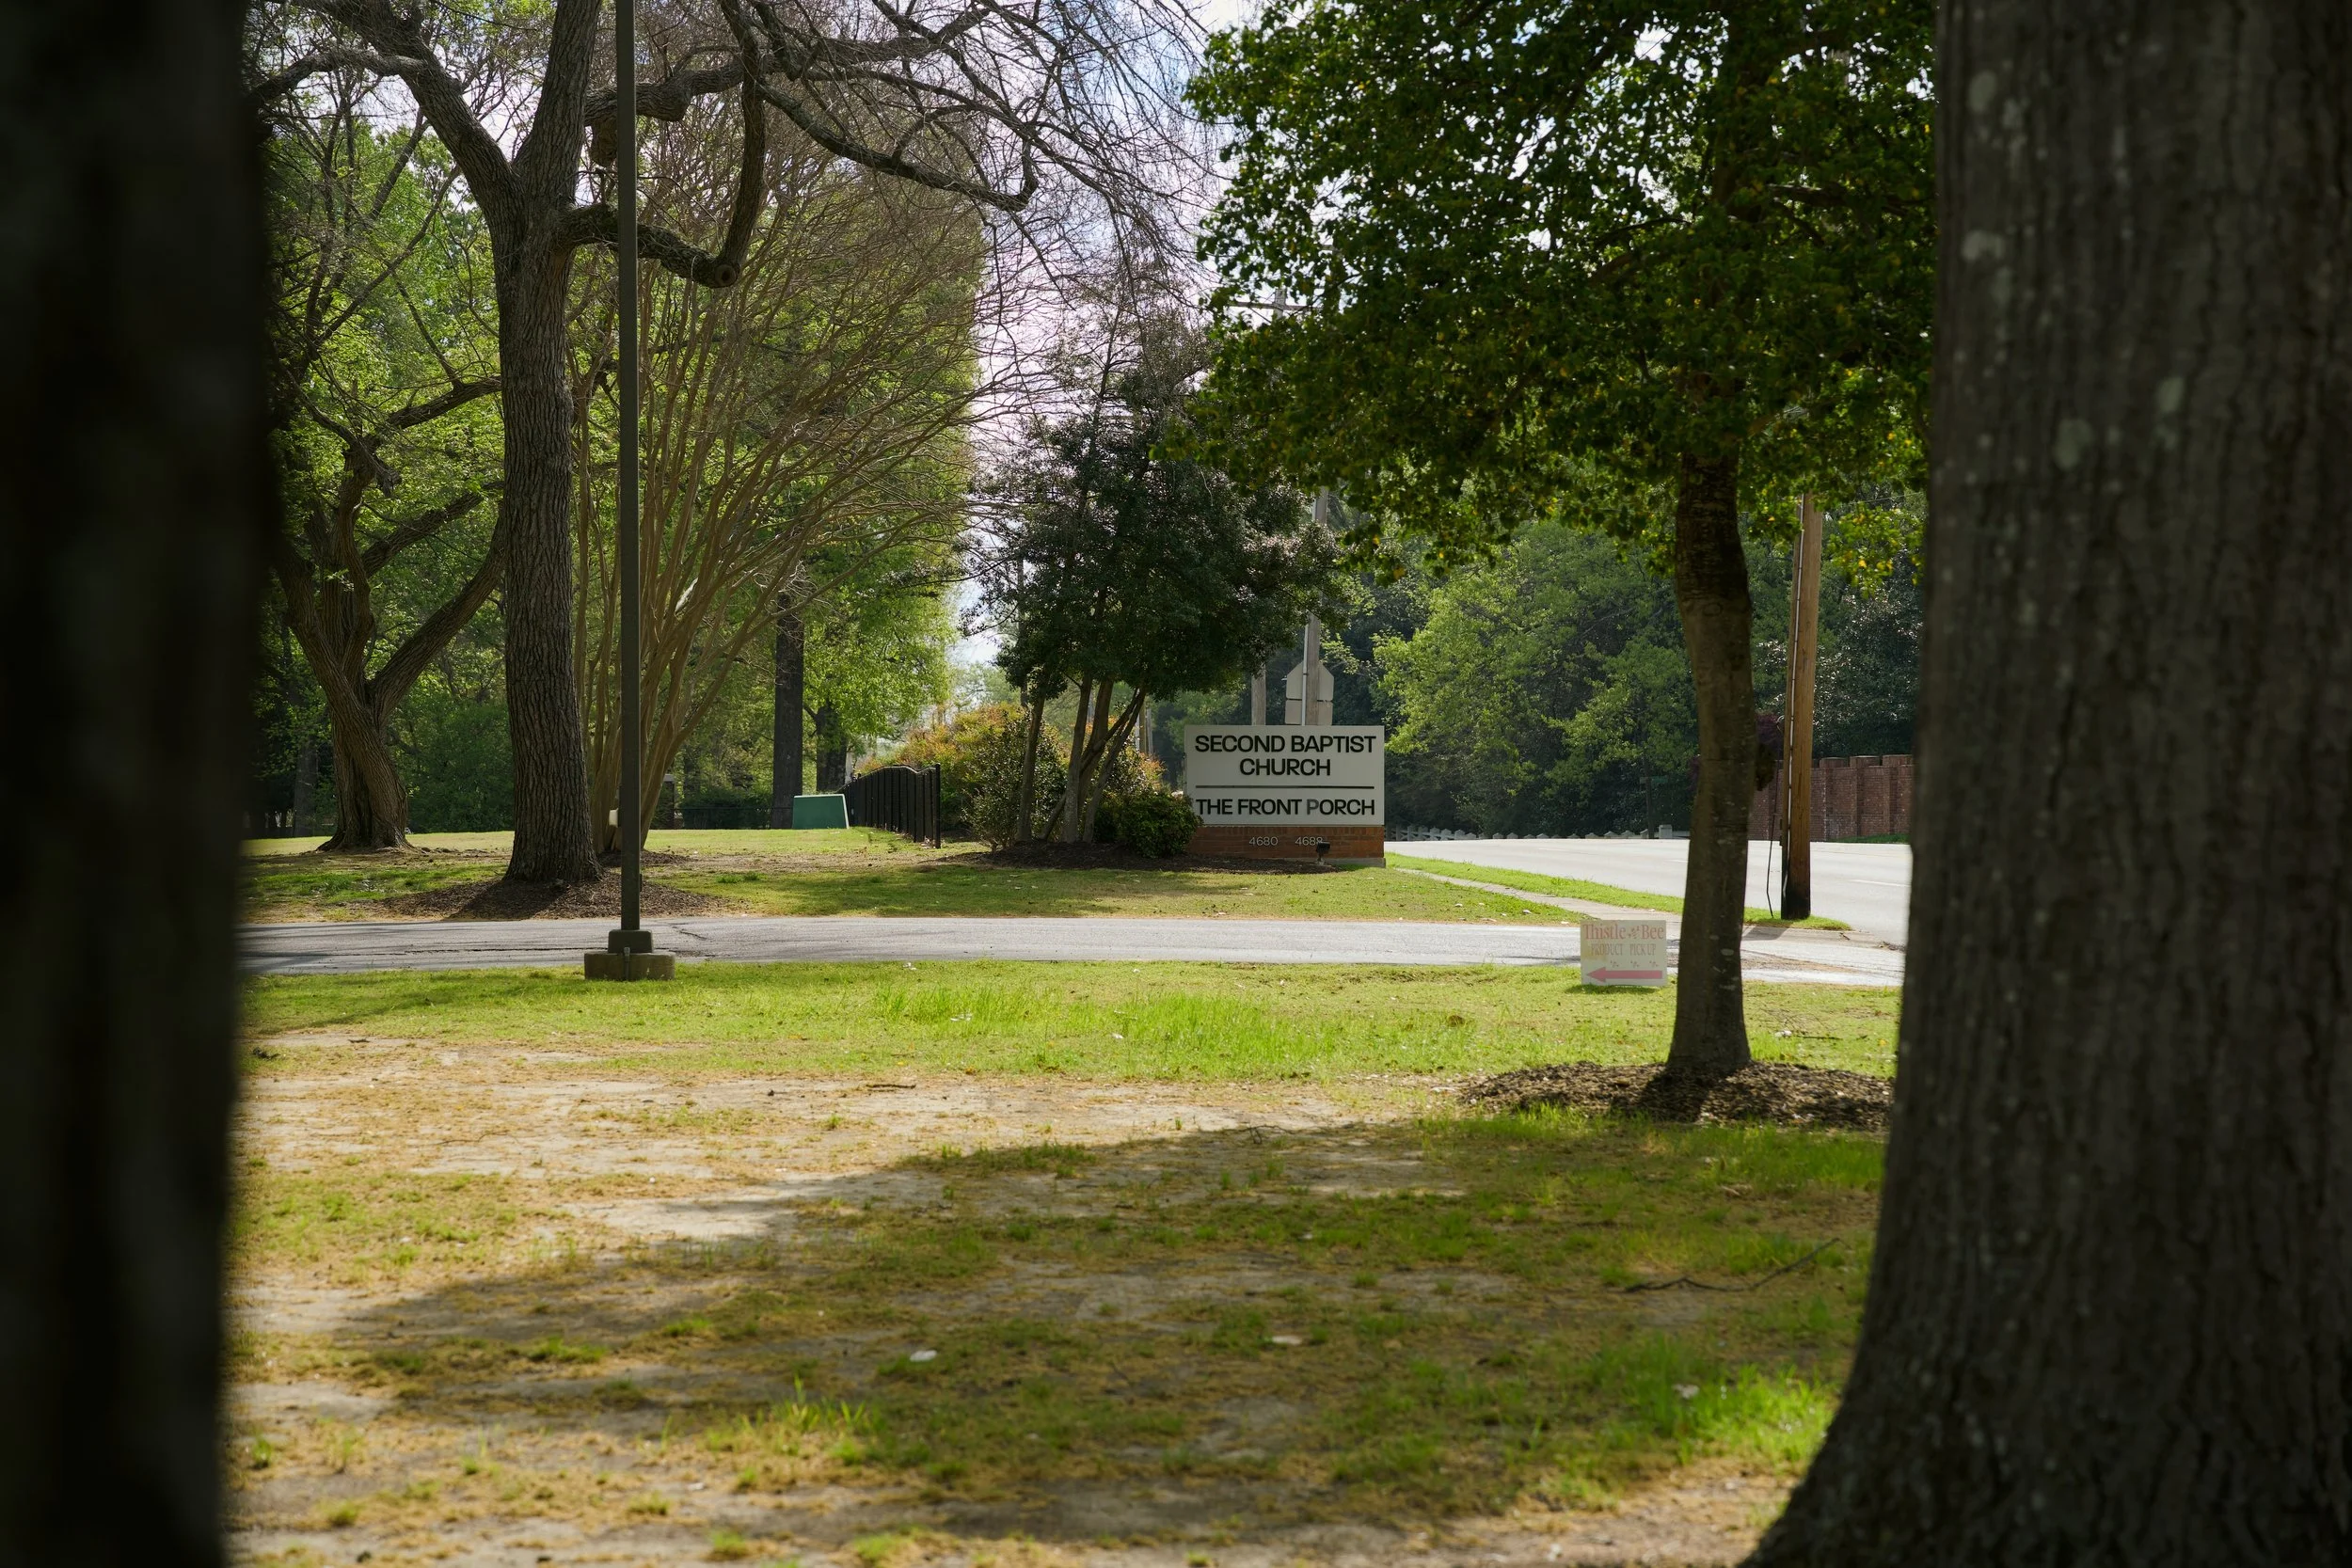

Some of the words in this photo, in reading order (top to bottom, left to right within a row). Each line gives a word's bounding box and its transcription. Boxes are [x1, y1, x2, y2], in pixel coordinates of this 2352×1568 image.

[1195, 735, 1285, 752] SECOND
[1291, 735, 1376, 752] BAPTIST
[1239, 758, 1331, 776] CHURCH
[1196, 799, 1232, 816] THE
[1238, 799, 1302, 816] FRONT
[1307, 799, 1375, 816] PORCH
[1248, 836, 1279, 847] 4680
[1583, 924, 1626, 940] Thistle
[1641, 925, 1664, 940] Bee
[1591, 942, 1623, 957] PRODUCT
